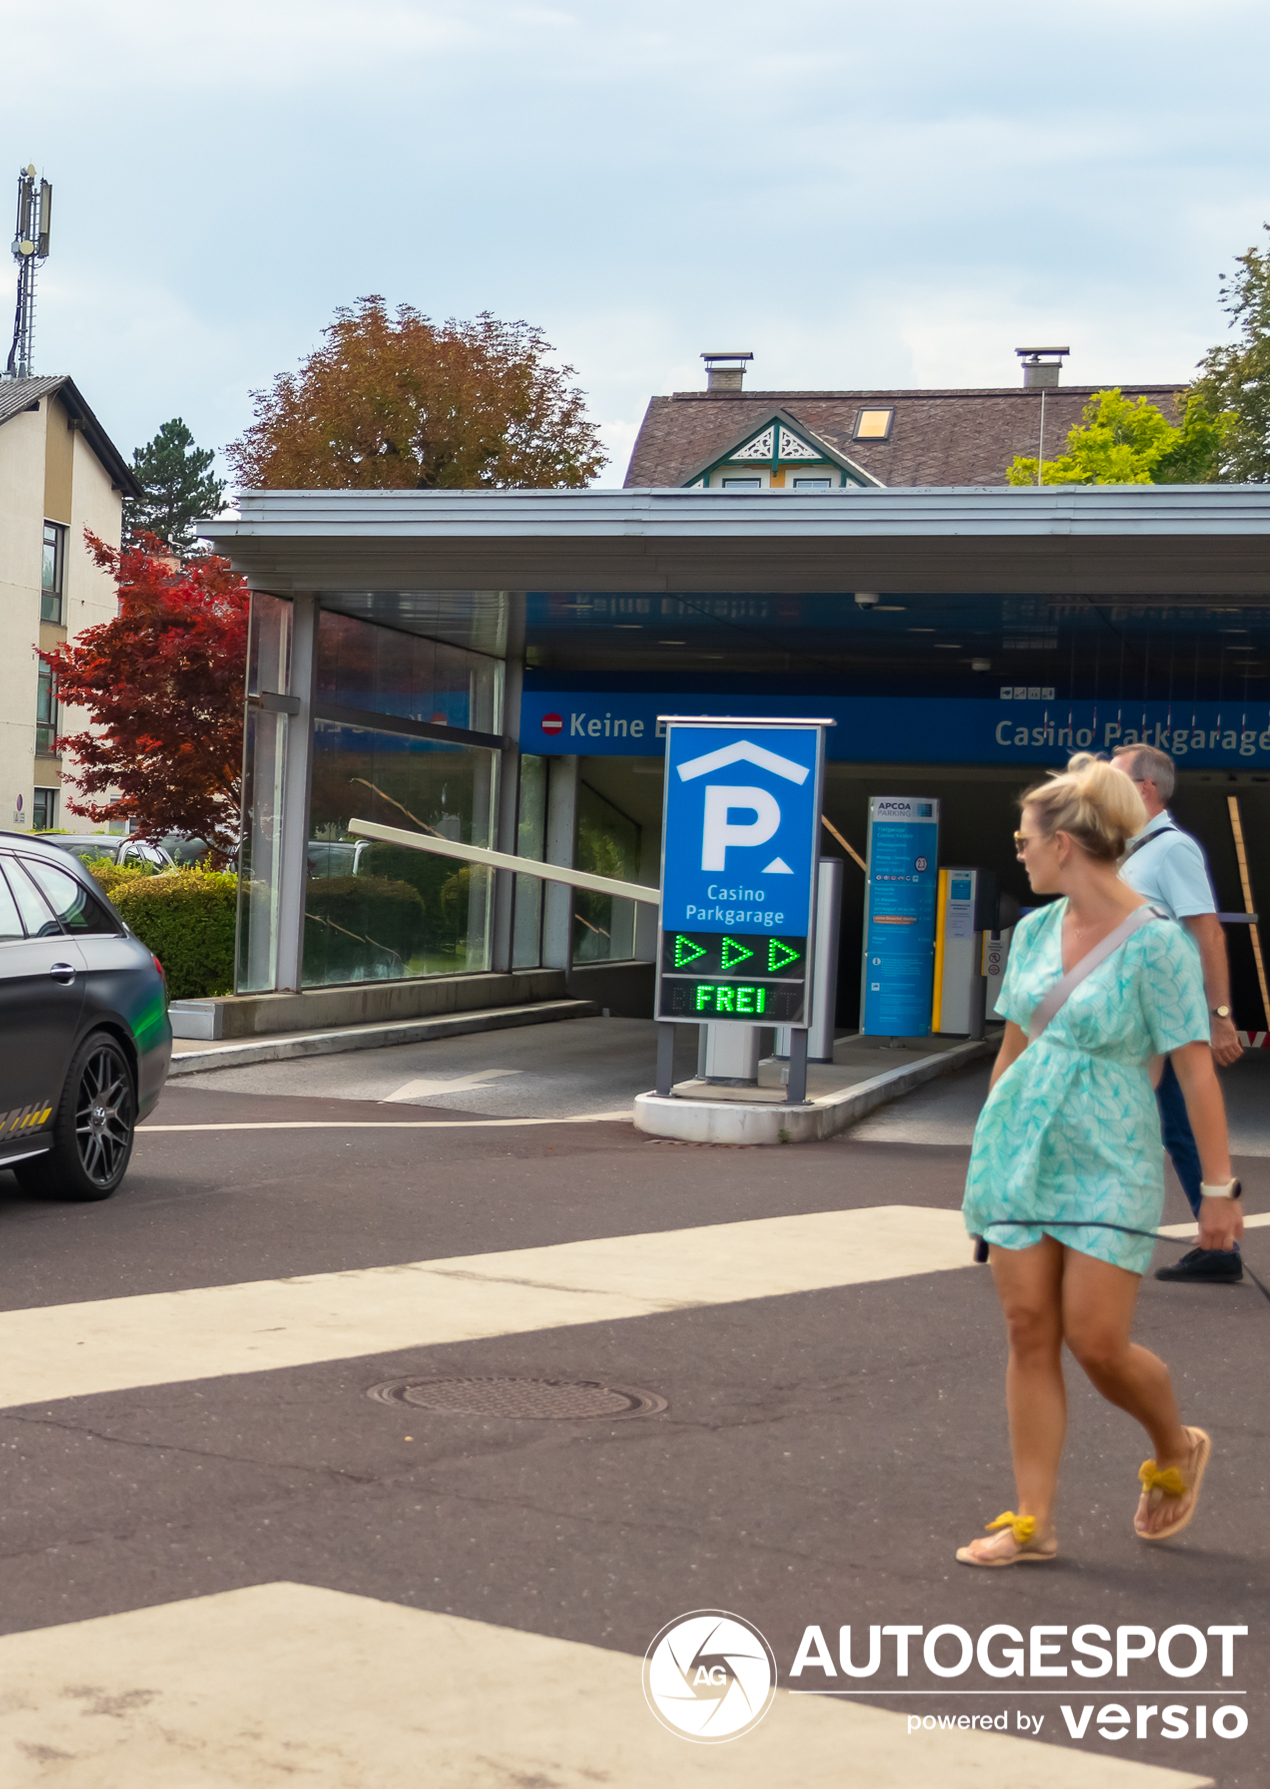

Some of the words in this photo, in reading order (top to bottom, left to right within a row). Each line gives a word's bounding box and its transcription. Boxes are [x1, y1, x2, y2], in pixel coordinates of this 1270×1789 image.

[570, 712, 645, 738] Keine
[995, 720, 1093, 747] Casino
[1104, 722, 1270, 756] Parkgarage
[878, 802, 912, 810] APCOA
[701, 785, 781, 872] P
[707, 884, 765, 902] Casino
[685, 905, 785, 927] Parkgarage
[696, 985, 766, 1014] FREI
